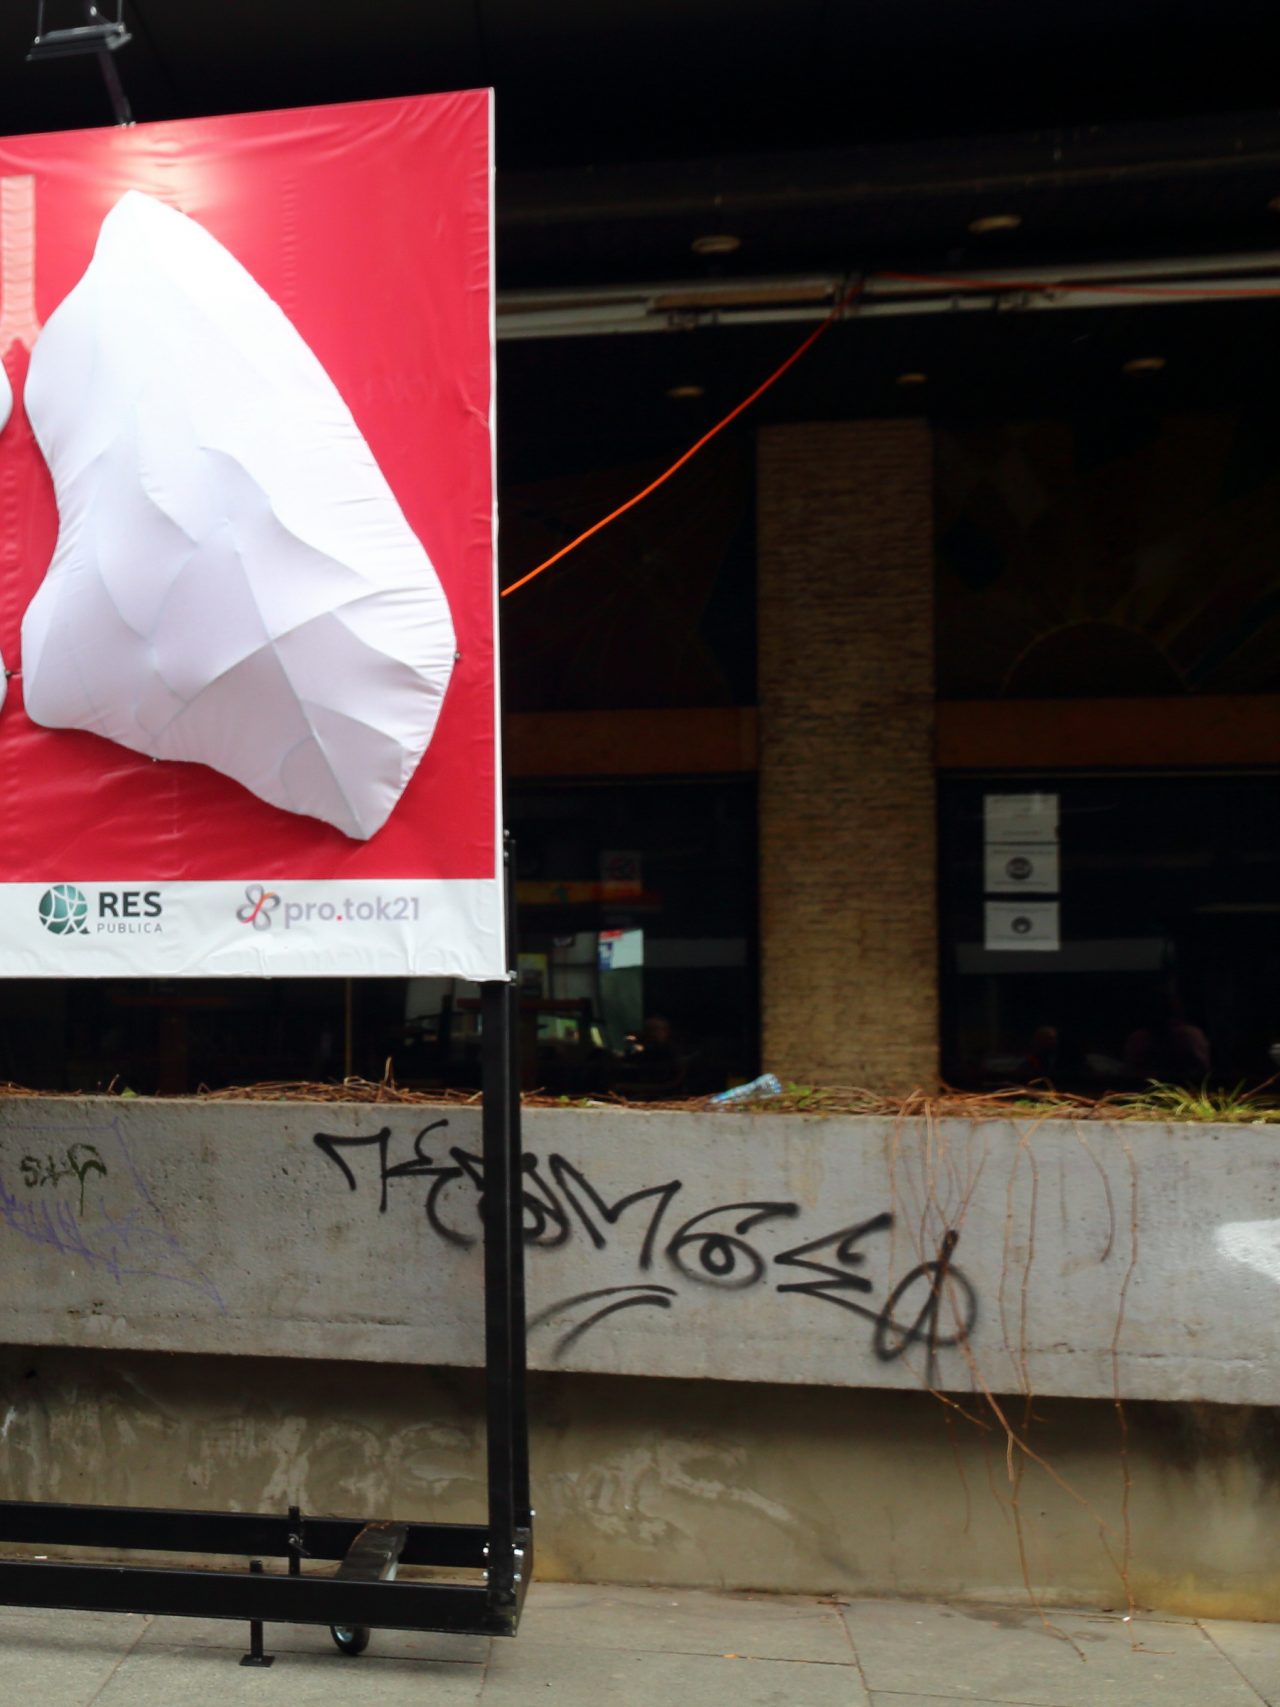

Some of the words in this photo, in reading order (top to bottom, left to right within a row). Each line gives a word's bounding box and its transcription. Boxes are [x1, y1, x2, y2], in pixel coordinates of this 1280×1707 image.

[99, 891, 163, 917] RES
[284, 896, 420, 930] pro.tok21
[97, 922, 163, 934] PUBLICA
